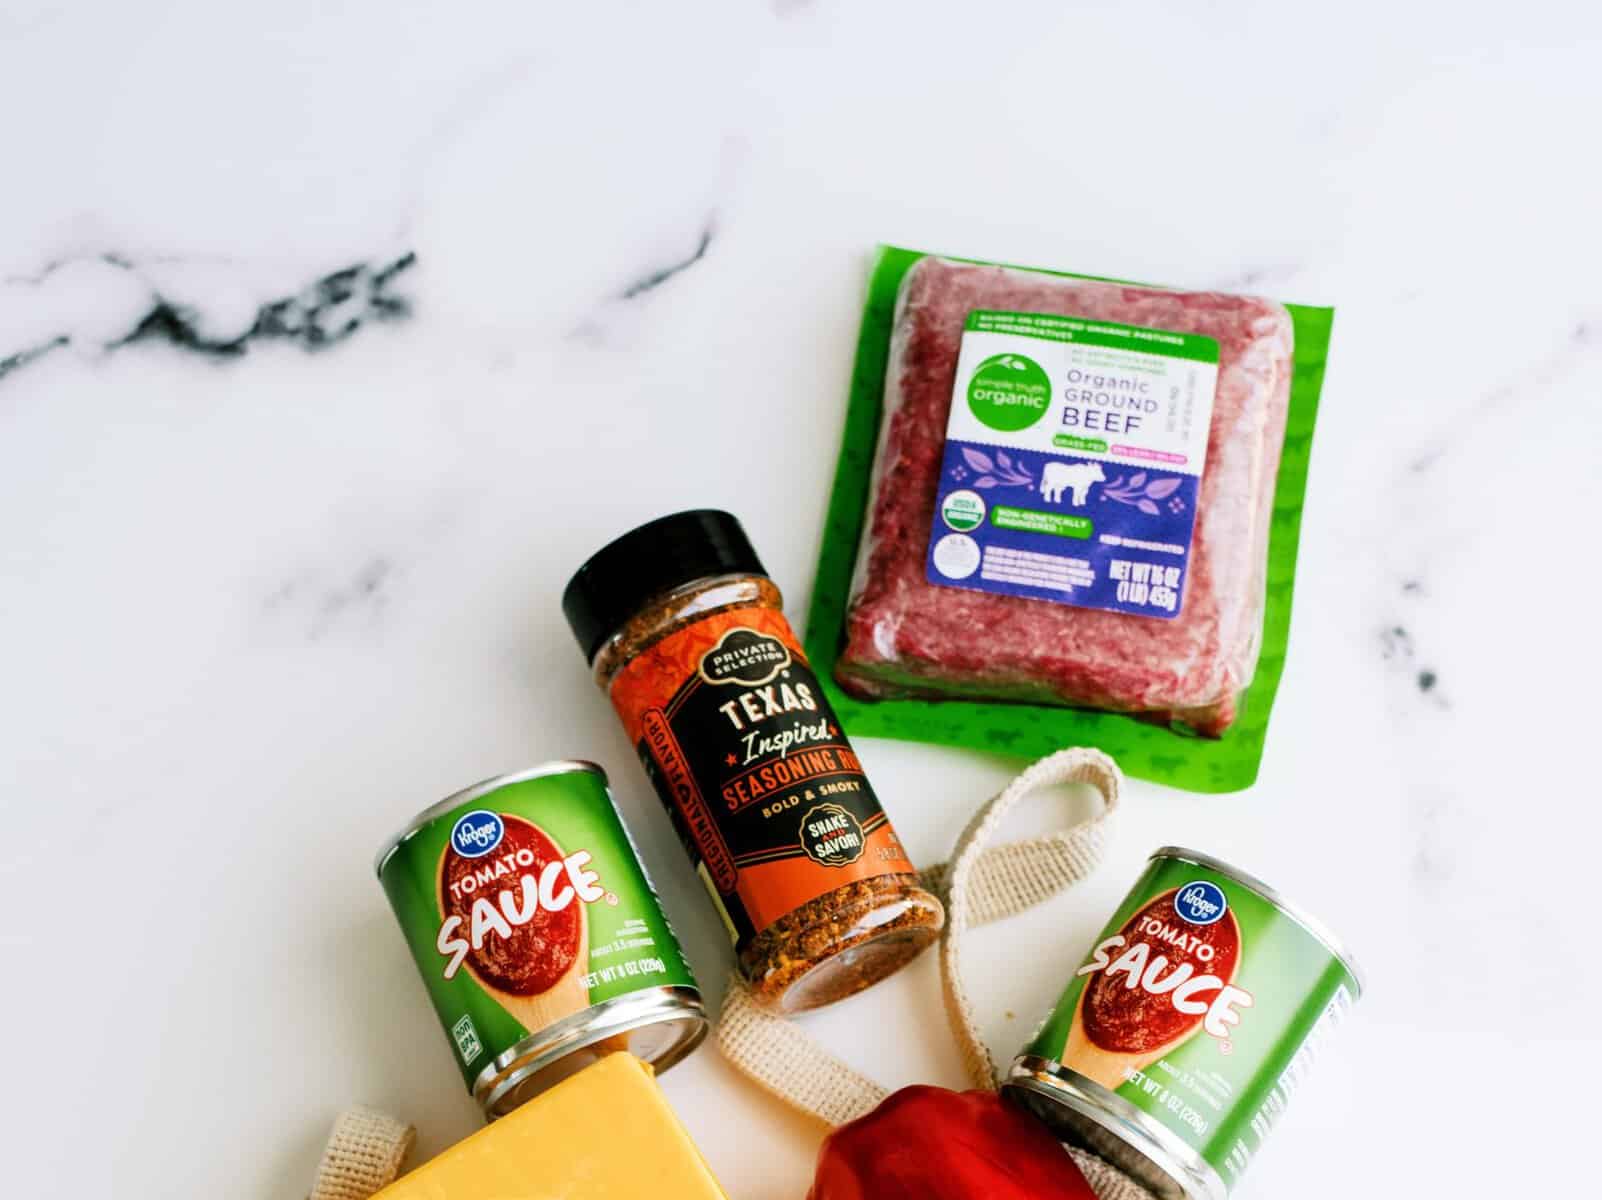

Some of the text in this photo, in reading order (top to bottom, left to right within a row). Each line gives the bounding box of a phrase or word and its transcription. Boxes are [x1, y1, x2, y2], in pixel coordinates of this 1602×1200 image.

[1066, 369, 1150, 394] Organic
[973, 389, 1045, 409] organic
[1064, 387, 1159, 414] GROUND
[1061, 406, 1144, 434] BEEF
[1109, 559, 1132, 581] NET
[1131, 562, 1152, 583] WT
[713, 642, 777, 666] PRIVATE
[714, 652, 784, 675] SELECTION
[718, 682, 818, 731] TEXAS
[649, 719, 685, 783] FLAVOR
[741, 717, 833, 766] Inspired
[722, 749, 837, 811] SEASONING
[761, 781, 861, 819] BOLD & SMOKY
[457, 821, 498, 848] Kroger
[687, 803, 731, 877] REGIONAL
[807, 814, 850, 838] SHAKE
[821, 828, 847, 843] AND
[814, 832, 861, 858] SAVOR!
[449, 848, 535, 900] TOMATO
[436, 850, 604, 979] SAUCE
[1182, 886, 1220, 918] Kroger
[1139, 916, 1215, 963] TOMATO
[579, 972, 600, 989] NET
[599, 966, 617, 984] WT
[624, 960, 642, 976] OZ
[1078, 934, 1253, 1038] SAUCE
[1123, 1066, 1147, 1086] NET
[1143, 1077, 1163, 1097] WT
[1167, 1095, 1184, 1113] OZ
